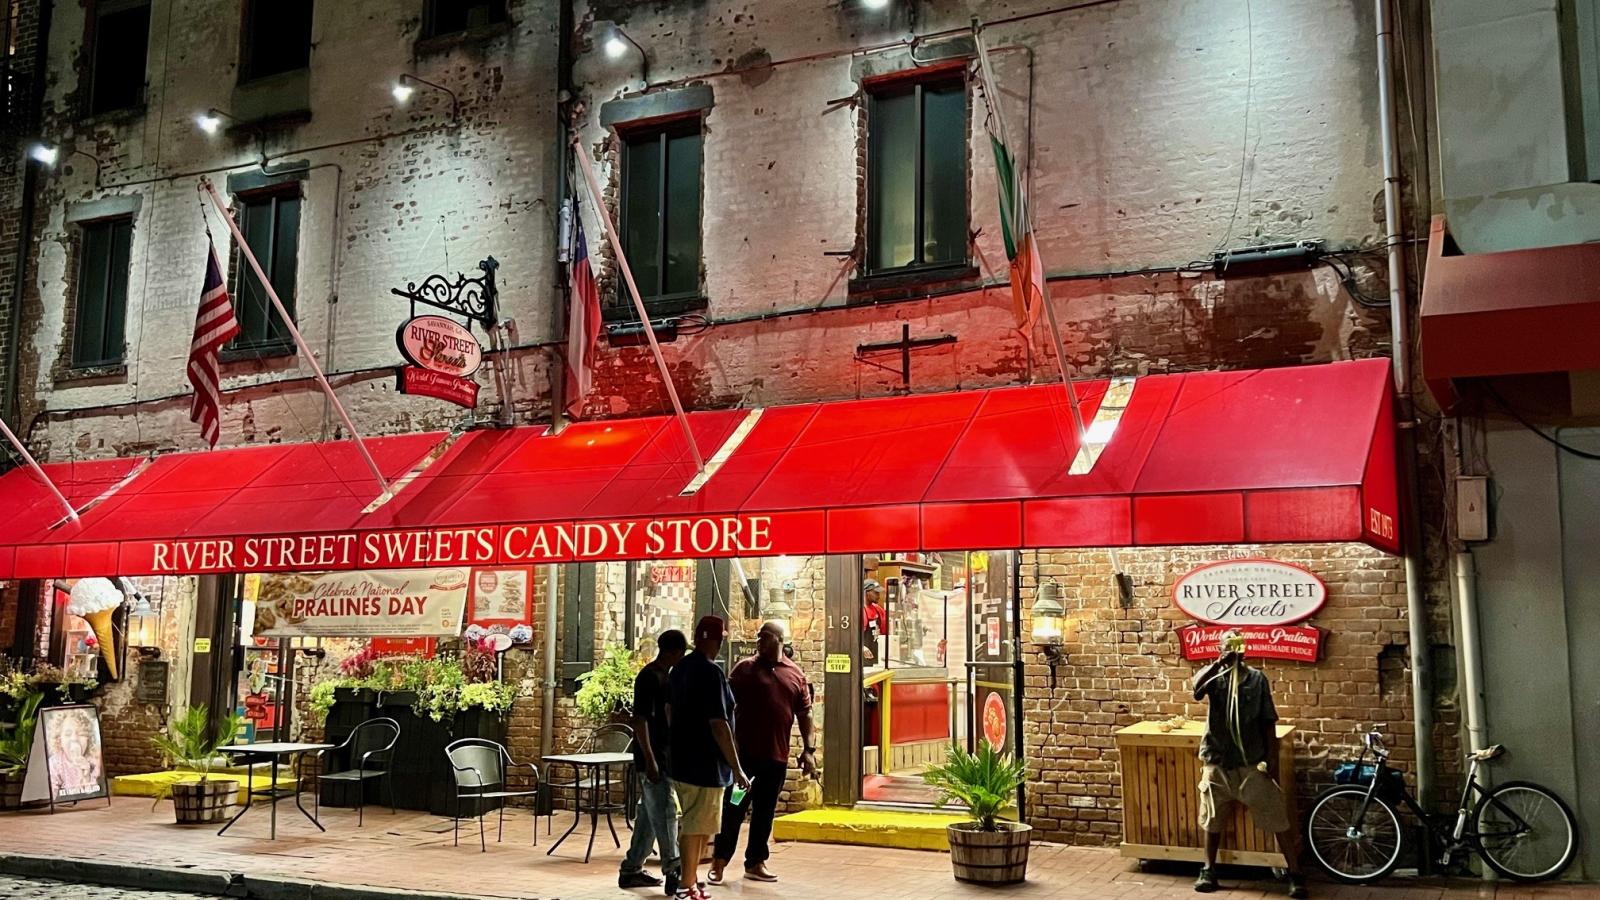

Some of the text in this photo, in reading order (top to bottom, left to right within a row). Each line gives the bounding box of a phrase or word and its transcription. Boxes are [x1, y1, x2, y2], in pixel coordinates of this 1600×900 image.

[411, 326, 475, 355] RIVER STREET
[406, 370, 428, 383] World
[152, 516, 773, 571] RIVER STREET SWEETS CANDY STORE
[314, 580, 410, 600] Celebrate National
[1183, 583, 1316, 599] RIVER STREET
[294, 597, 381, 616] PRALINES
[388, 596, 428, 616] DAY
[828, 615, 850, 629] 13
[1186, 630, 1224, 646] World
[1269, 628, 1316, 645] Pralines
[1190, 646, 1205, 654] SALT
[1252, 644, 1291, 653] HOMEMADE
[1291, 646, 1313, 656] FUDGE
